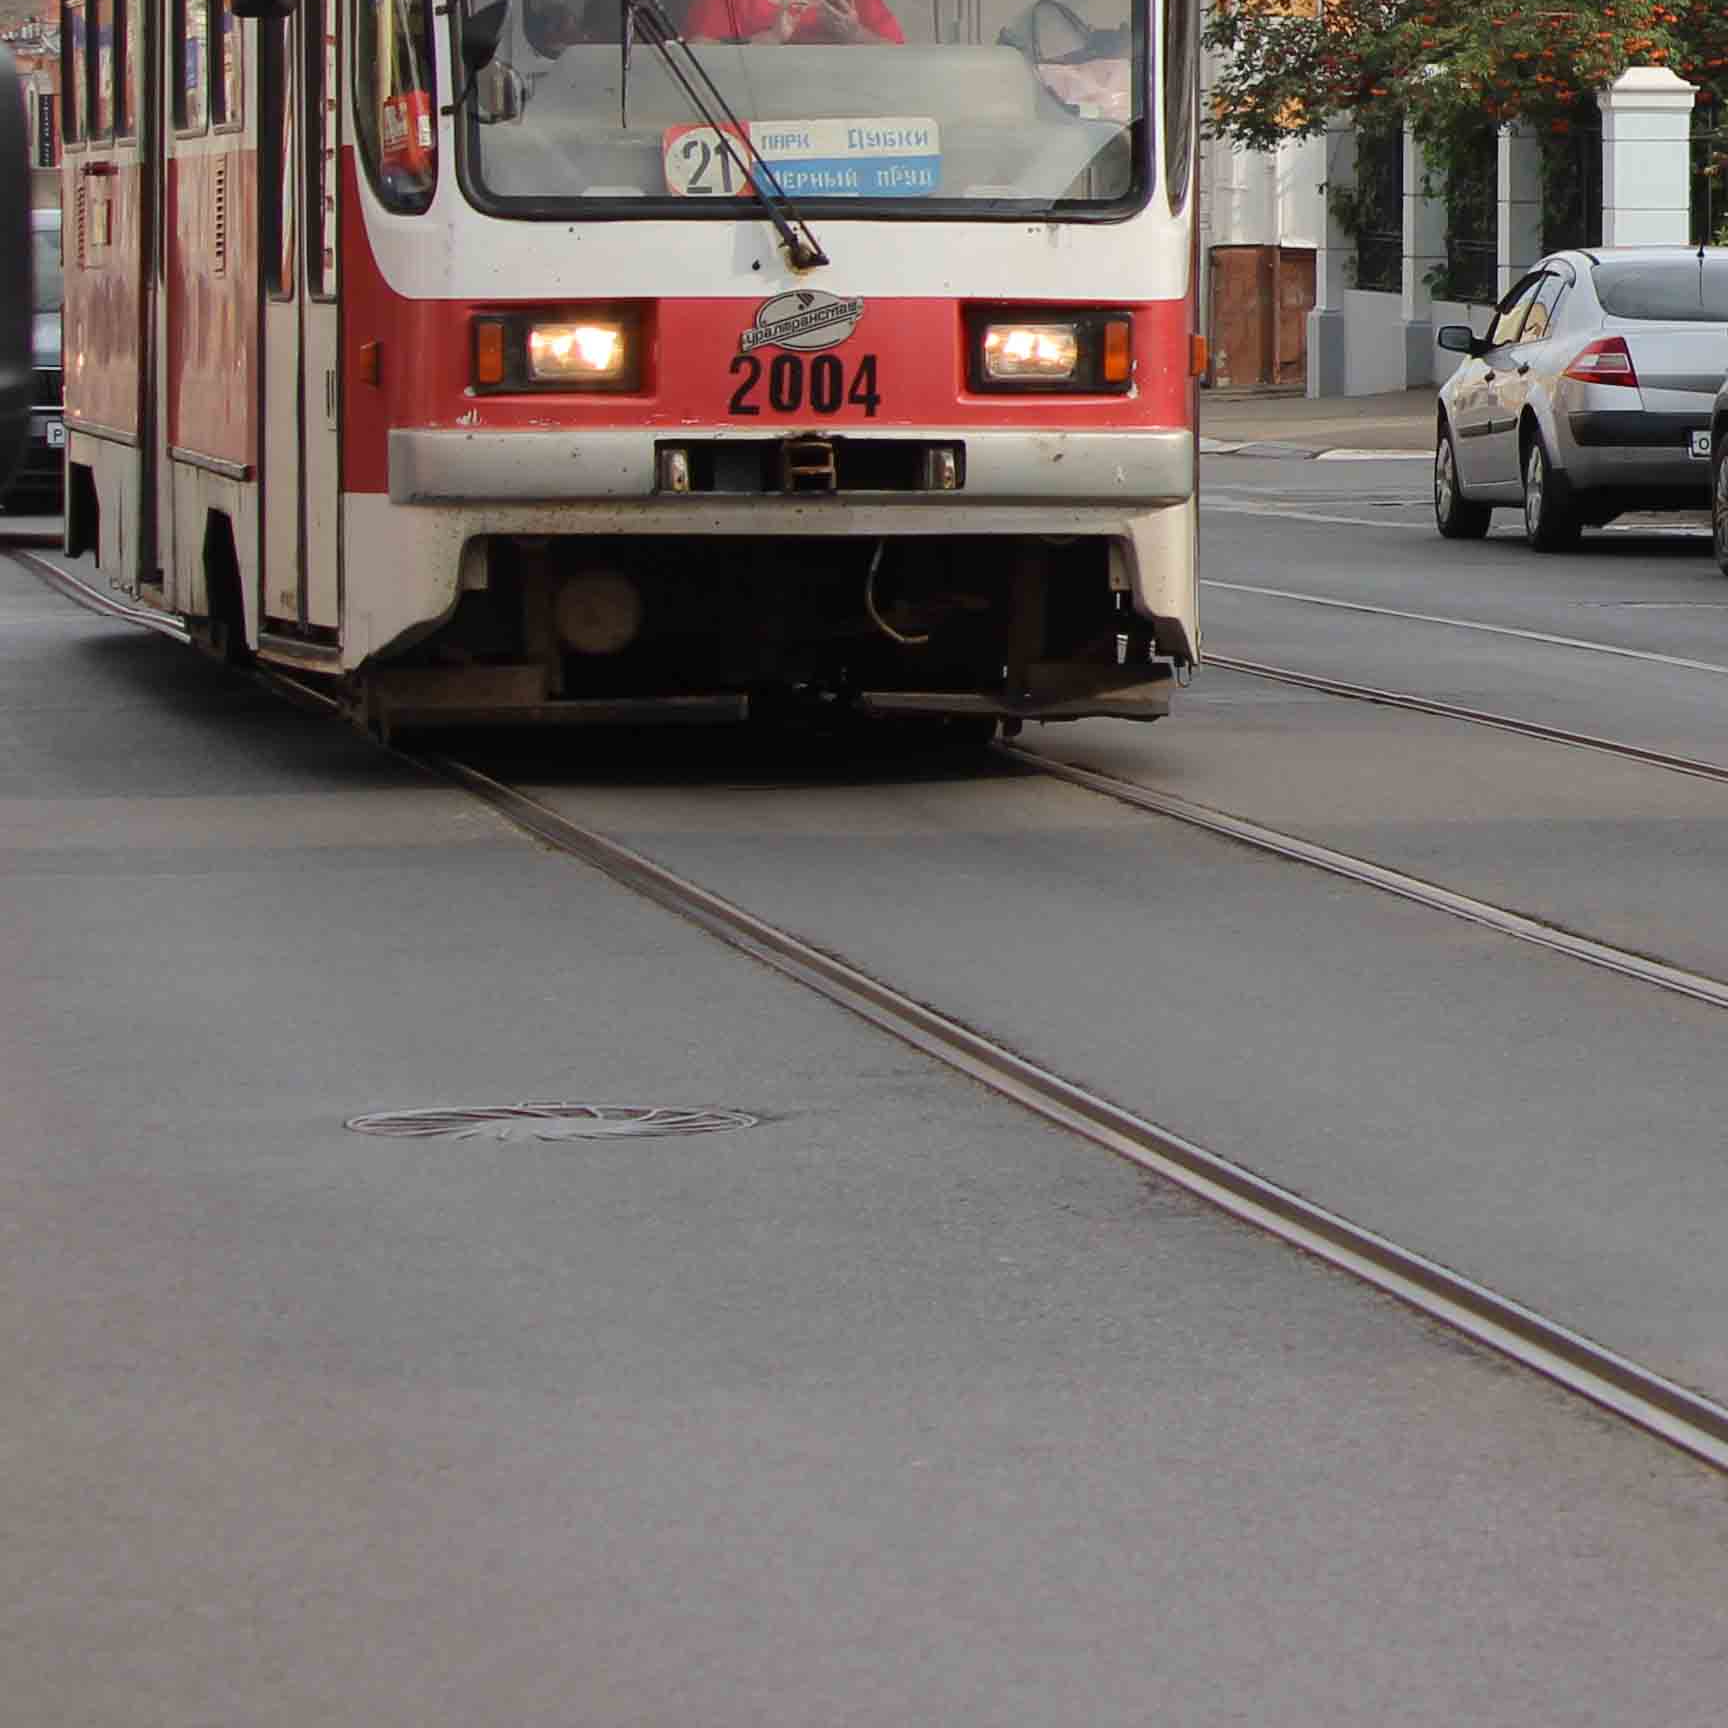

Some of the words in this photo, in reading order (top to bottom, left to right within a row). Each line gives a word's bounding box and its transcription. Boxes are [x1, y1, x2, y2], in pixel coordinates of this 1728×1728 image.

[682, 136, 734, 194] 21
[760, 133, 810, 151] ПАРК
[847, 127, 929, 150] ДУБКИ
[728, 353, 881, 417] 2004
